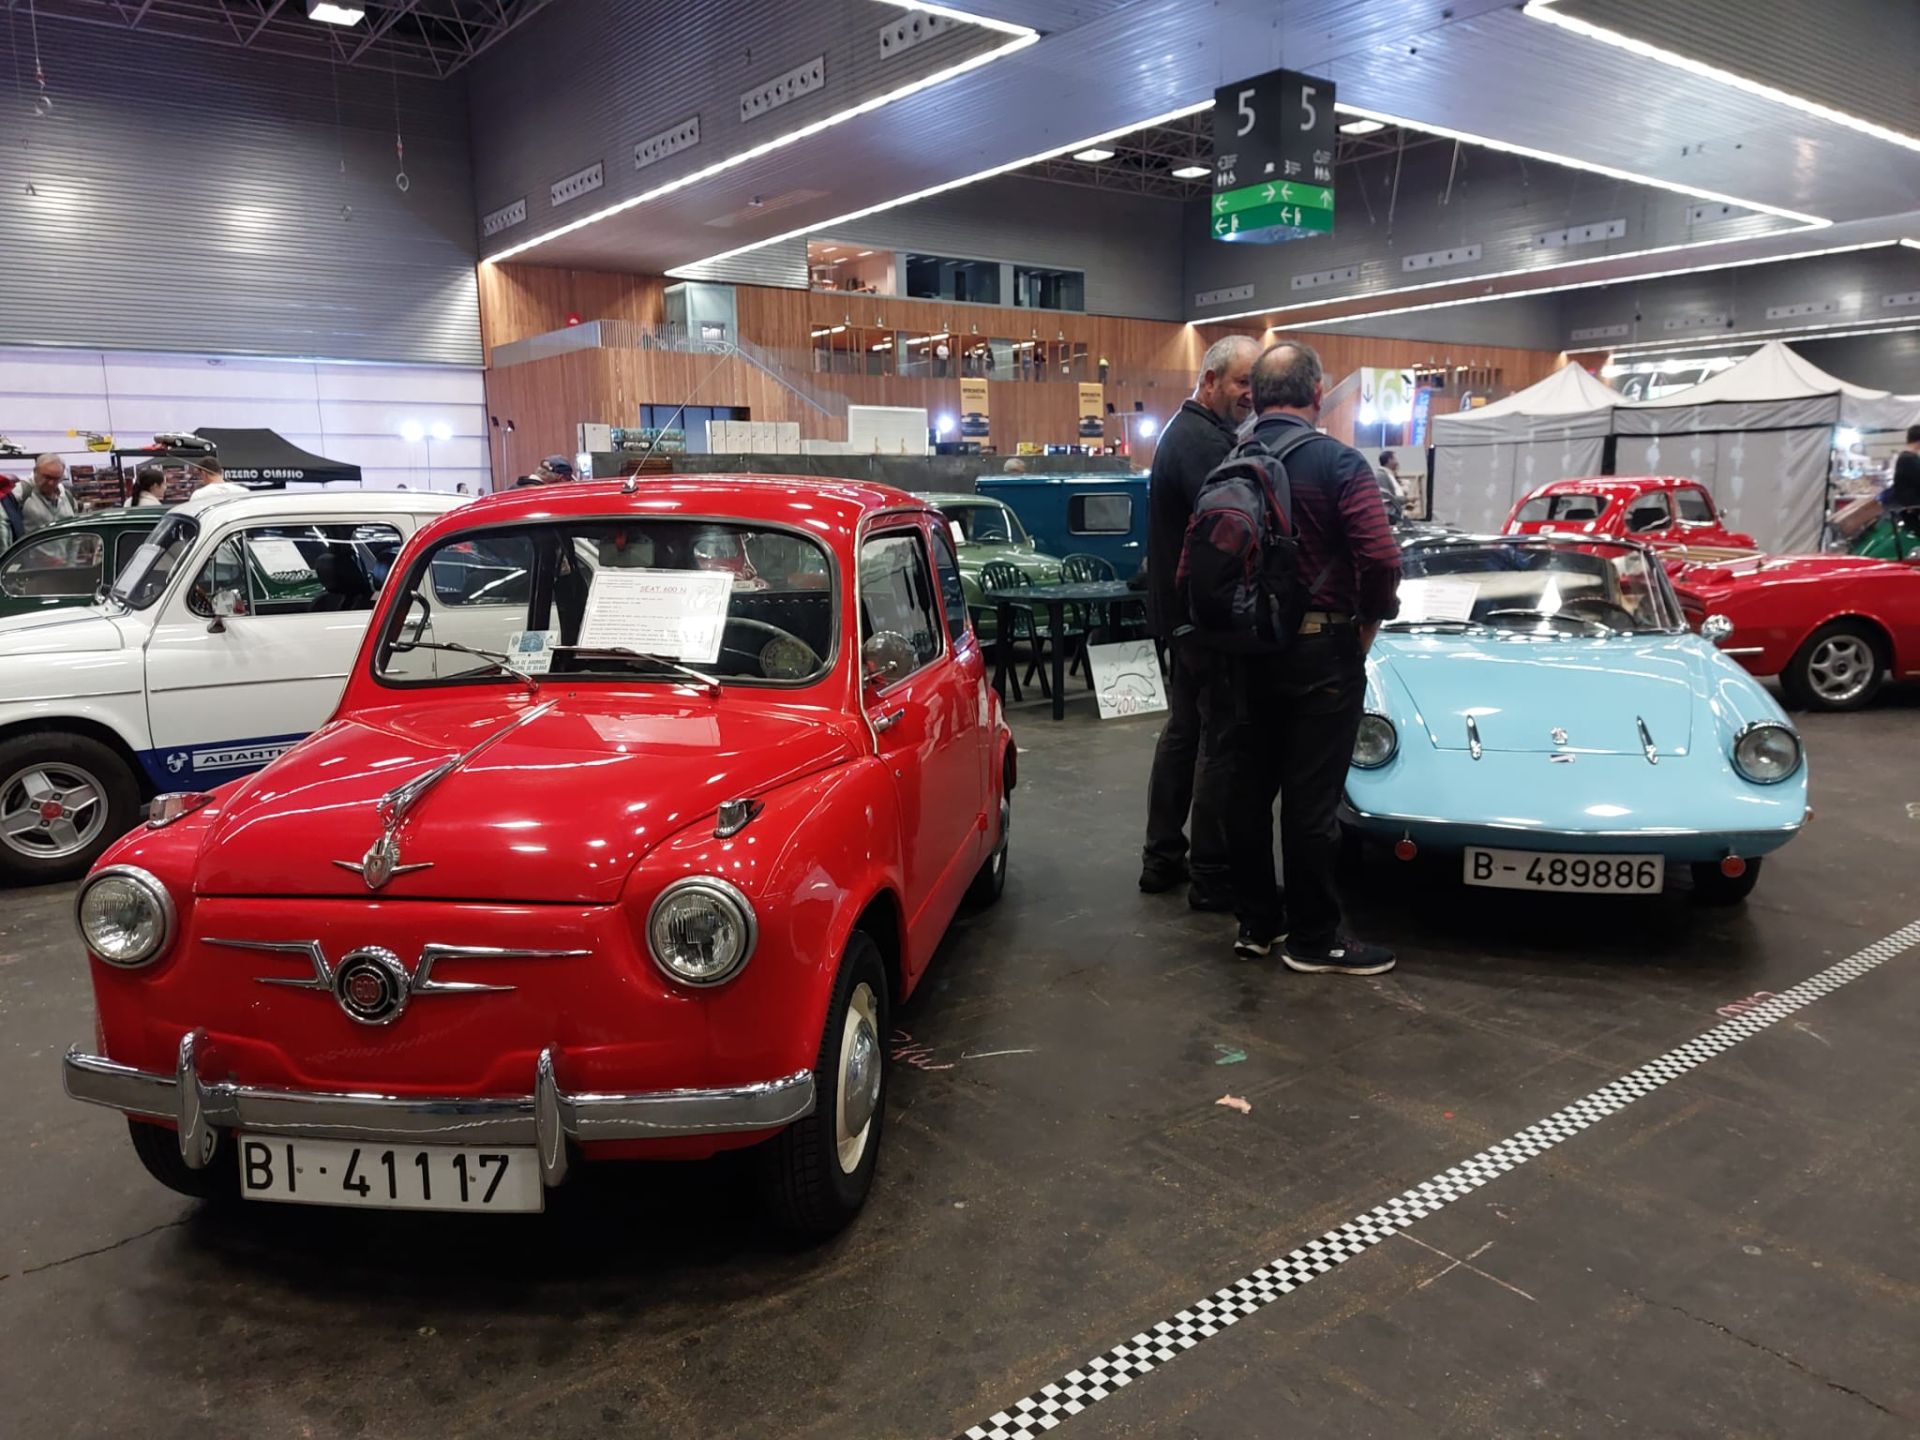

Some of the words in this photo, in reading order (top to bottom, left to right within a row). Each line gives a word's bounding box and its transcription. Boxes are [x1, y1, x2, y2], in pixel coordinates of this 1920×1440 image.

[1237, 89, 1256, 137] 5
[1300, 85, 1316, 131] 5
[1378, 370, 1400, 415] 6
[1473, 851, 1656, 889] B-489886
